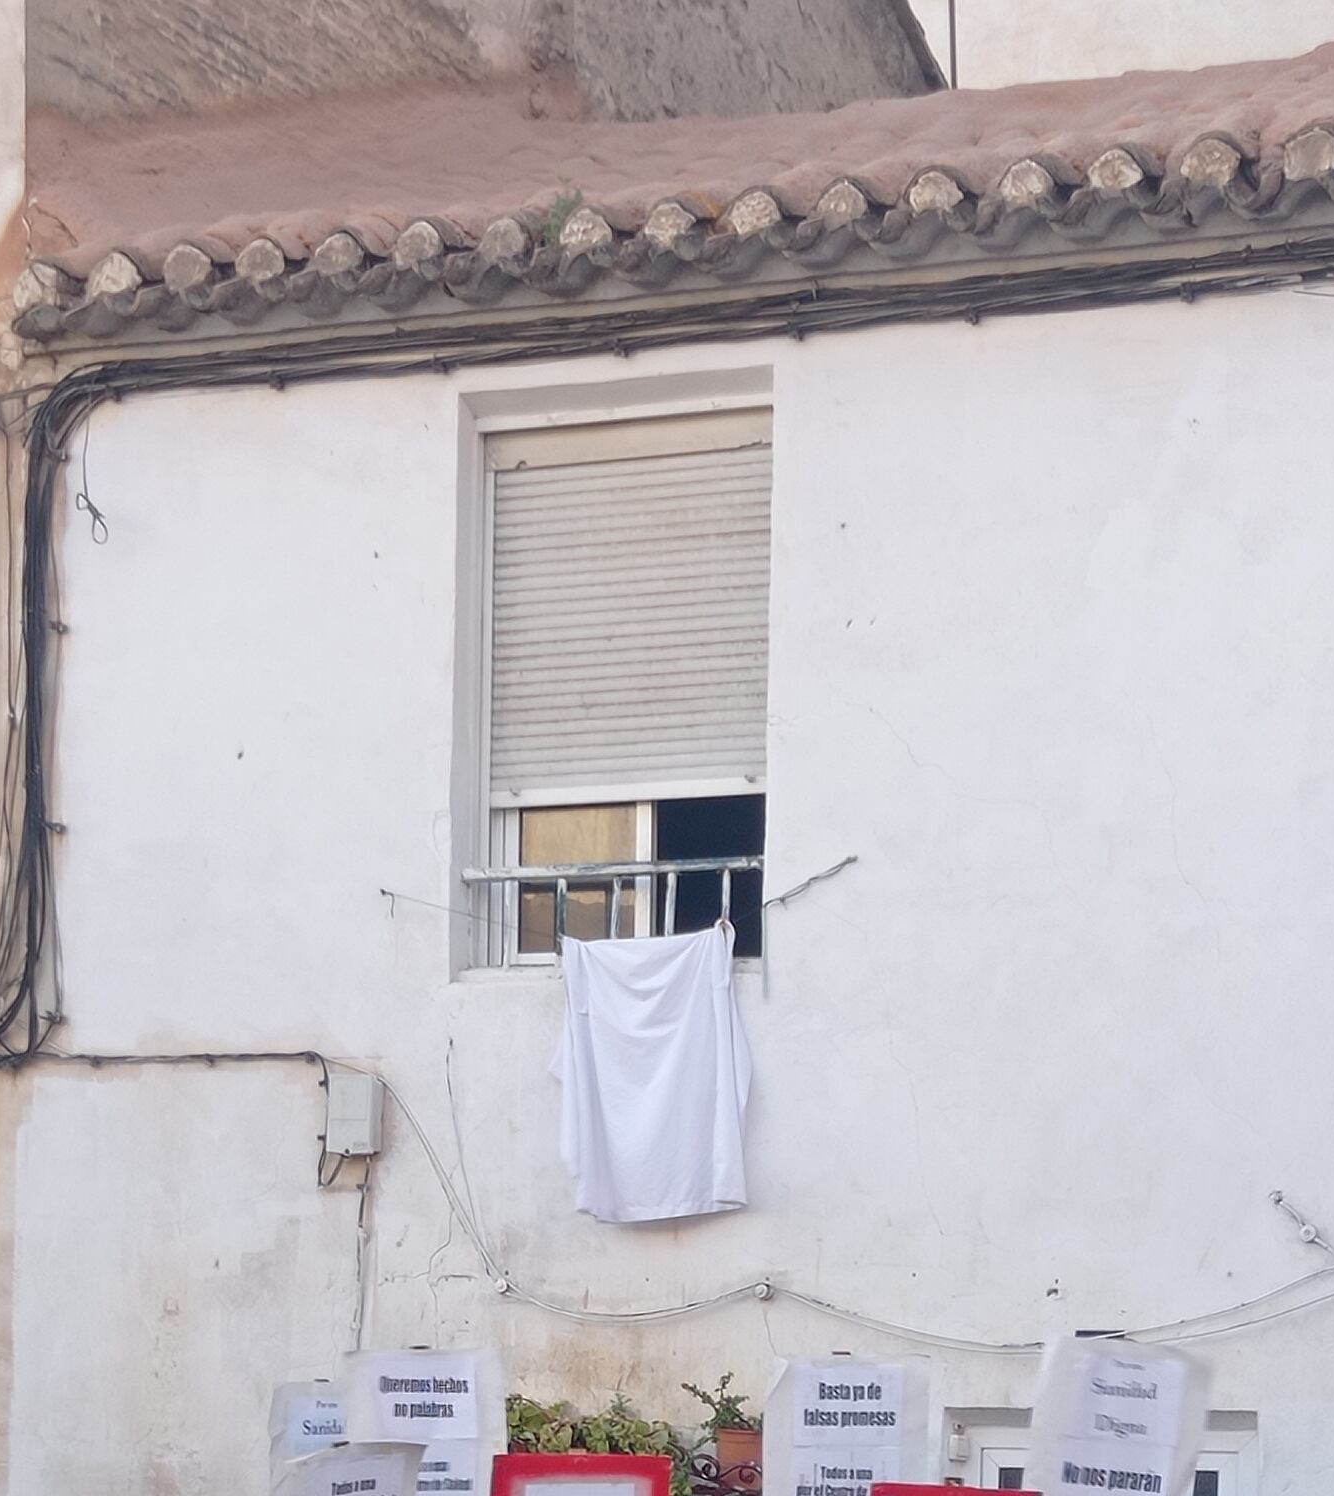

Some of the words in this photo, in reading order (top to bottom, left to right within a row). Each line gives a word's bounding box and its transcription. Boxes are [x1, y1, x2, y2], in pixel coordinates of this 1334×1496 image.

[379, 1376, 431, 1393] Queremos
[432, 1376, 469, 1393] hechos
[818, 1382, 851, 1400] Basta
[852, 1384, 865, 1401] ya
[867, 1382, 882, 1400] de
[394, 1402, 408, 1417] no
[410, 1401, 454, 1419] palabras
[804, 1408, 839, 1426] falsas
[840, 1411, 896, 1428] promesas
[821, 1466, 848, 1480] Todos
[849, 1469, 855, 1480] a
[1061, 1460, 1080, 1484] No
[1080, 1465, 1107, 1488] nos
[814, 1484, 824, 1496] el
